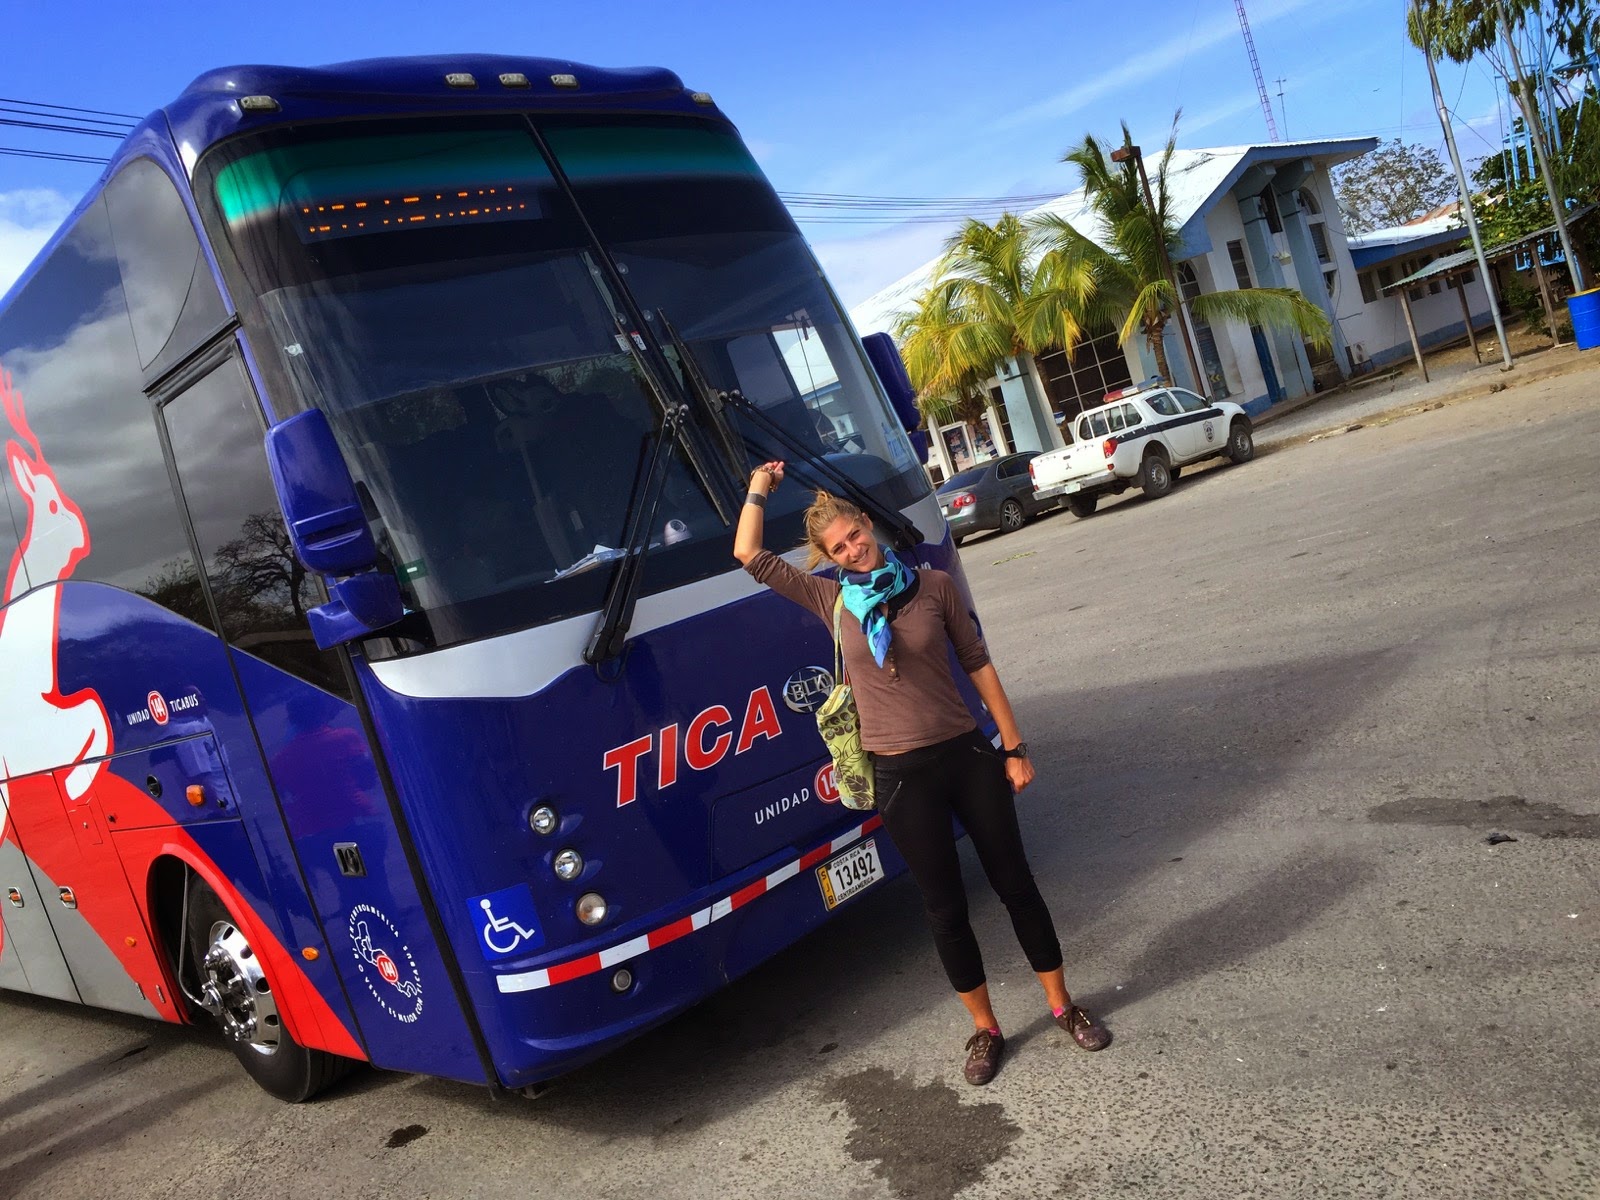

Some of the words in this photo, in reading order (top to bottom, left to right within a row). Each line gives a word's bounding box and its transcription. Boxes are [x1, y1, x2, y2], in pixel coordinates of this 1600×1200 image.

[790, 673, 831, 702] BLK
[126, 709, 150, 725] UNIDAD
[151, 698, 166, 718] 144
[169, 693, 199, 713] TICABUS
[602, 684, 783, 808] TICA
[754, 787, 810, 825] UNIDAD
[820, 770, 839, 796] 14
[833, 857, 849, 869] COSTA
[849, 849, 861, 859] RICA
[837, 875, 875, 902] CENTROAMERICA
